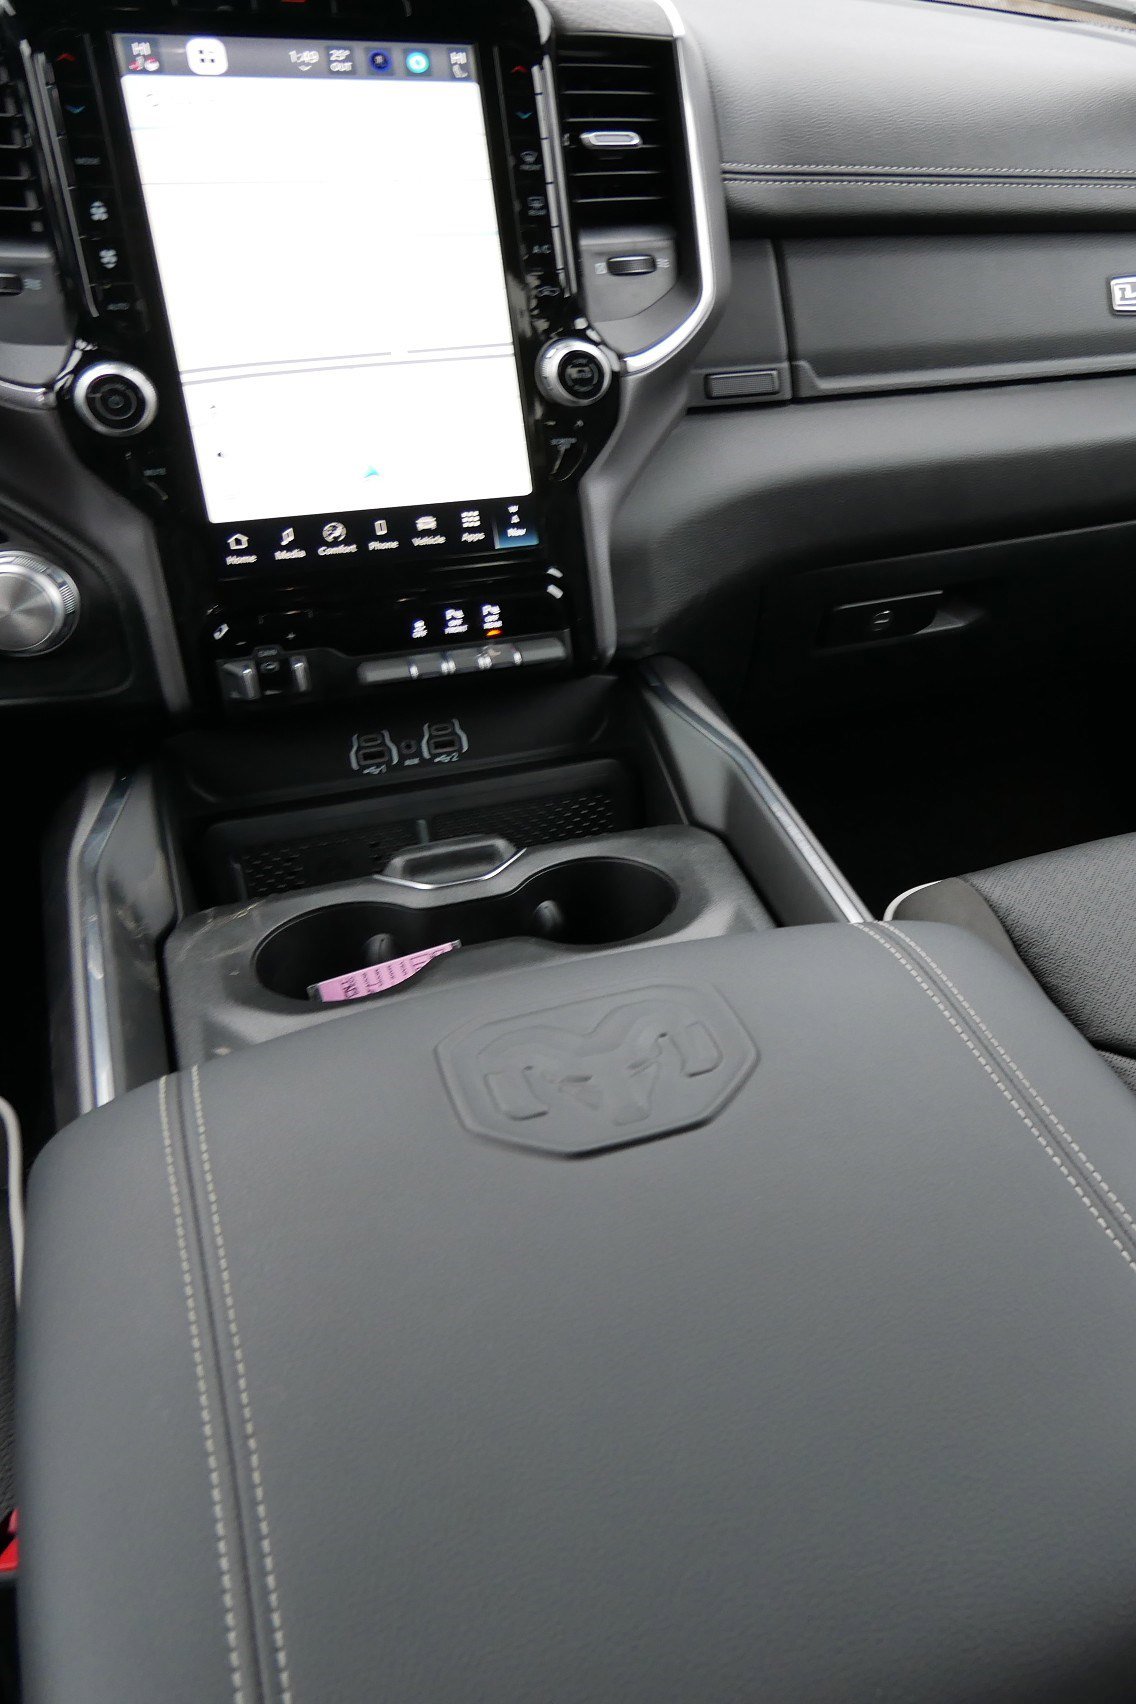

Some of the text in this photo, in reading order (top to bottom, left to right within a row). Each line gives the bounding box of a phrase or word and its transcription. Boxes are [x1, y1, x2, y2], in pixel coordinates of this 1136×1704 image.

[288, 50, 319, 64] 1:49
[329, 62, 352, 72] OUT
[412, 535, 446, 546] Vehicle
[461, 532, 485, 542] Apps
[318, 544, 358, 555] Comfort
[368, 540, 400, 551] Phone
[226, 555, 258, 565] Home
[274, 549, 307, 560] Media
